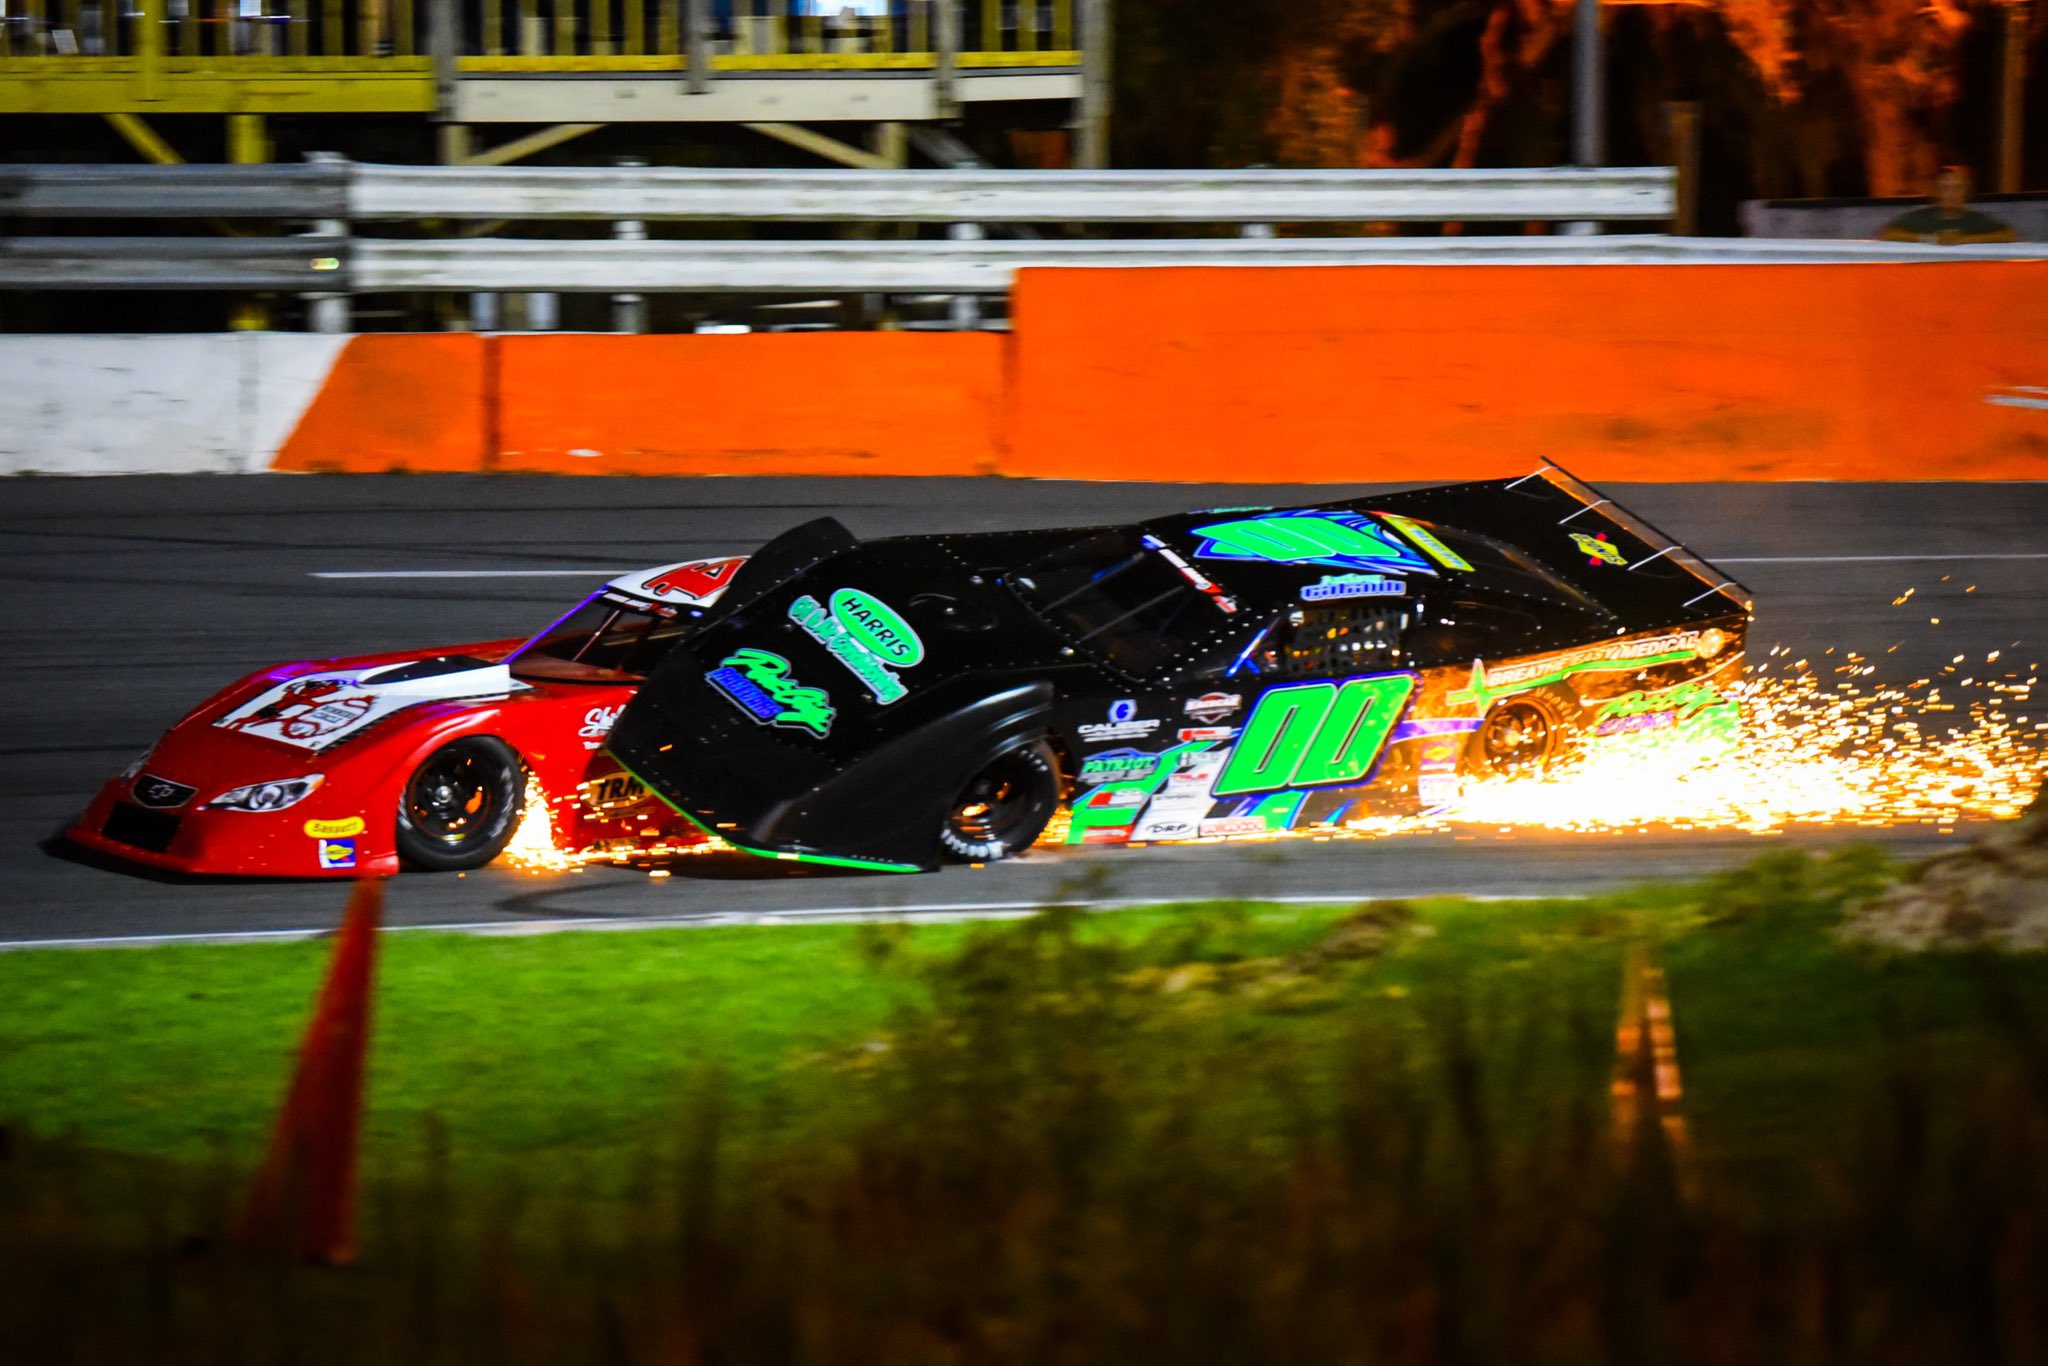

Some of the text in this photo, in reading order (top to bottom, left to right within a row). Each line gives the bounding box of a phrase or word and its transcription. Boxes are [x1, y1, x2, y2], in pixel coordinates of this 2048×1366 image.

[841, 597, 911, 657] HARRIS
[1487, 657, 1567, 686] BREATHE
[1618, 633, 1698, 659] MEDICAL
[1211, 674, 1415, 796] 00
